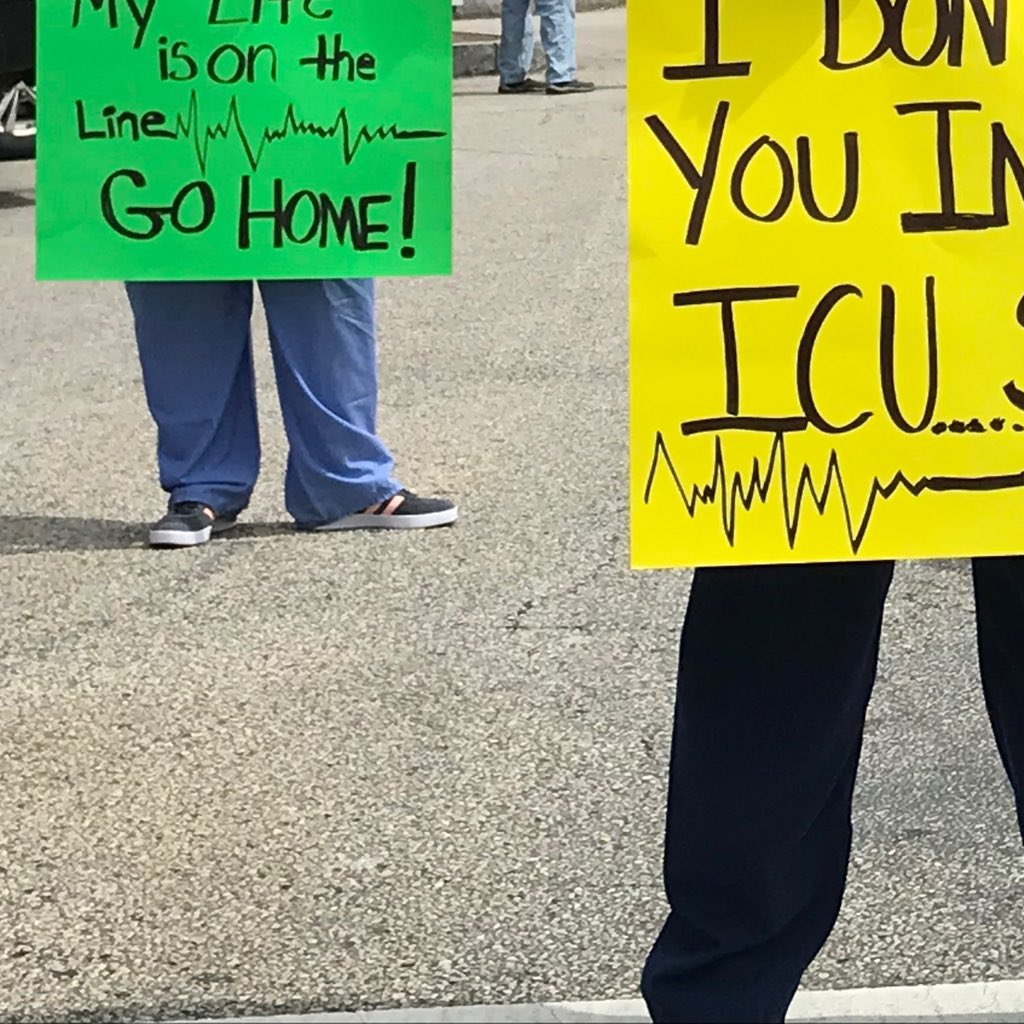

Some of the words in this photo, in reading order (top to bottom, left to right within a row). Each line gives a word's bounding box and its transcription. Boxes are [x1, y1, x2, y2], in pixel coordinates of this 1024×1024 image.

[300, 34, 377, 82] the
[75, 99, 177, 141] Line
[645, 102, 858, 245] YOU
[101, 169, 215, 240] GO
[238, 162, 416, 259] HOME!
